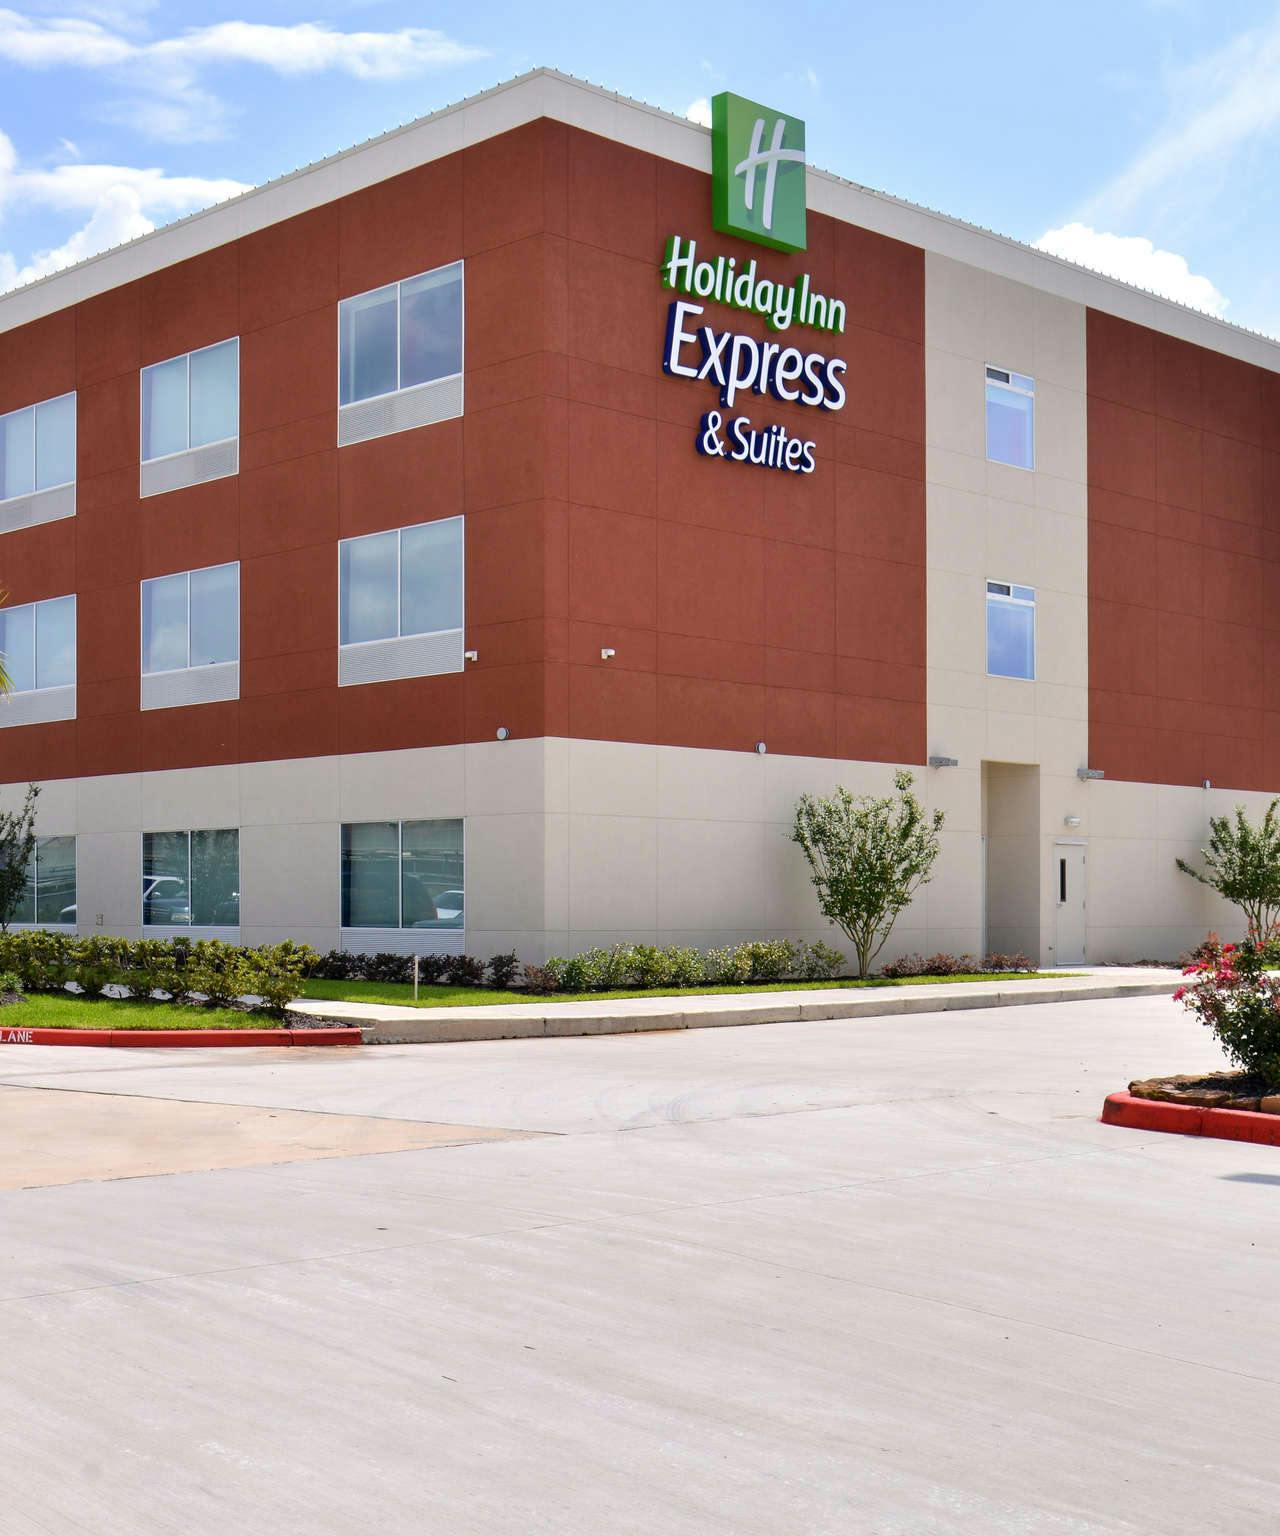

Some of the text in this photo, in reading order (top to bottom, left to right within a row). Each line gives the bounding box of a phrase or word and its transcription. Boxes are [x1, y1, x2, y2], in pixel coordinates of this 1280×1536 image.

[664, 235, 847, 334] Holiday Inn
[666, 300, 848, 411] Express
[700, 410, 817, 474] & Suites
[0, 1030, 34, 1043] LANE
